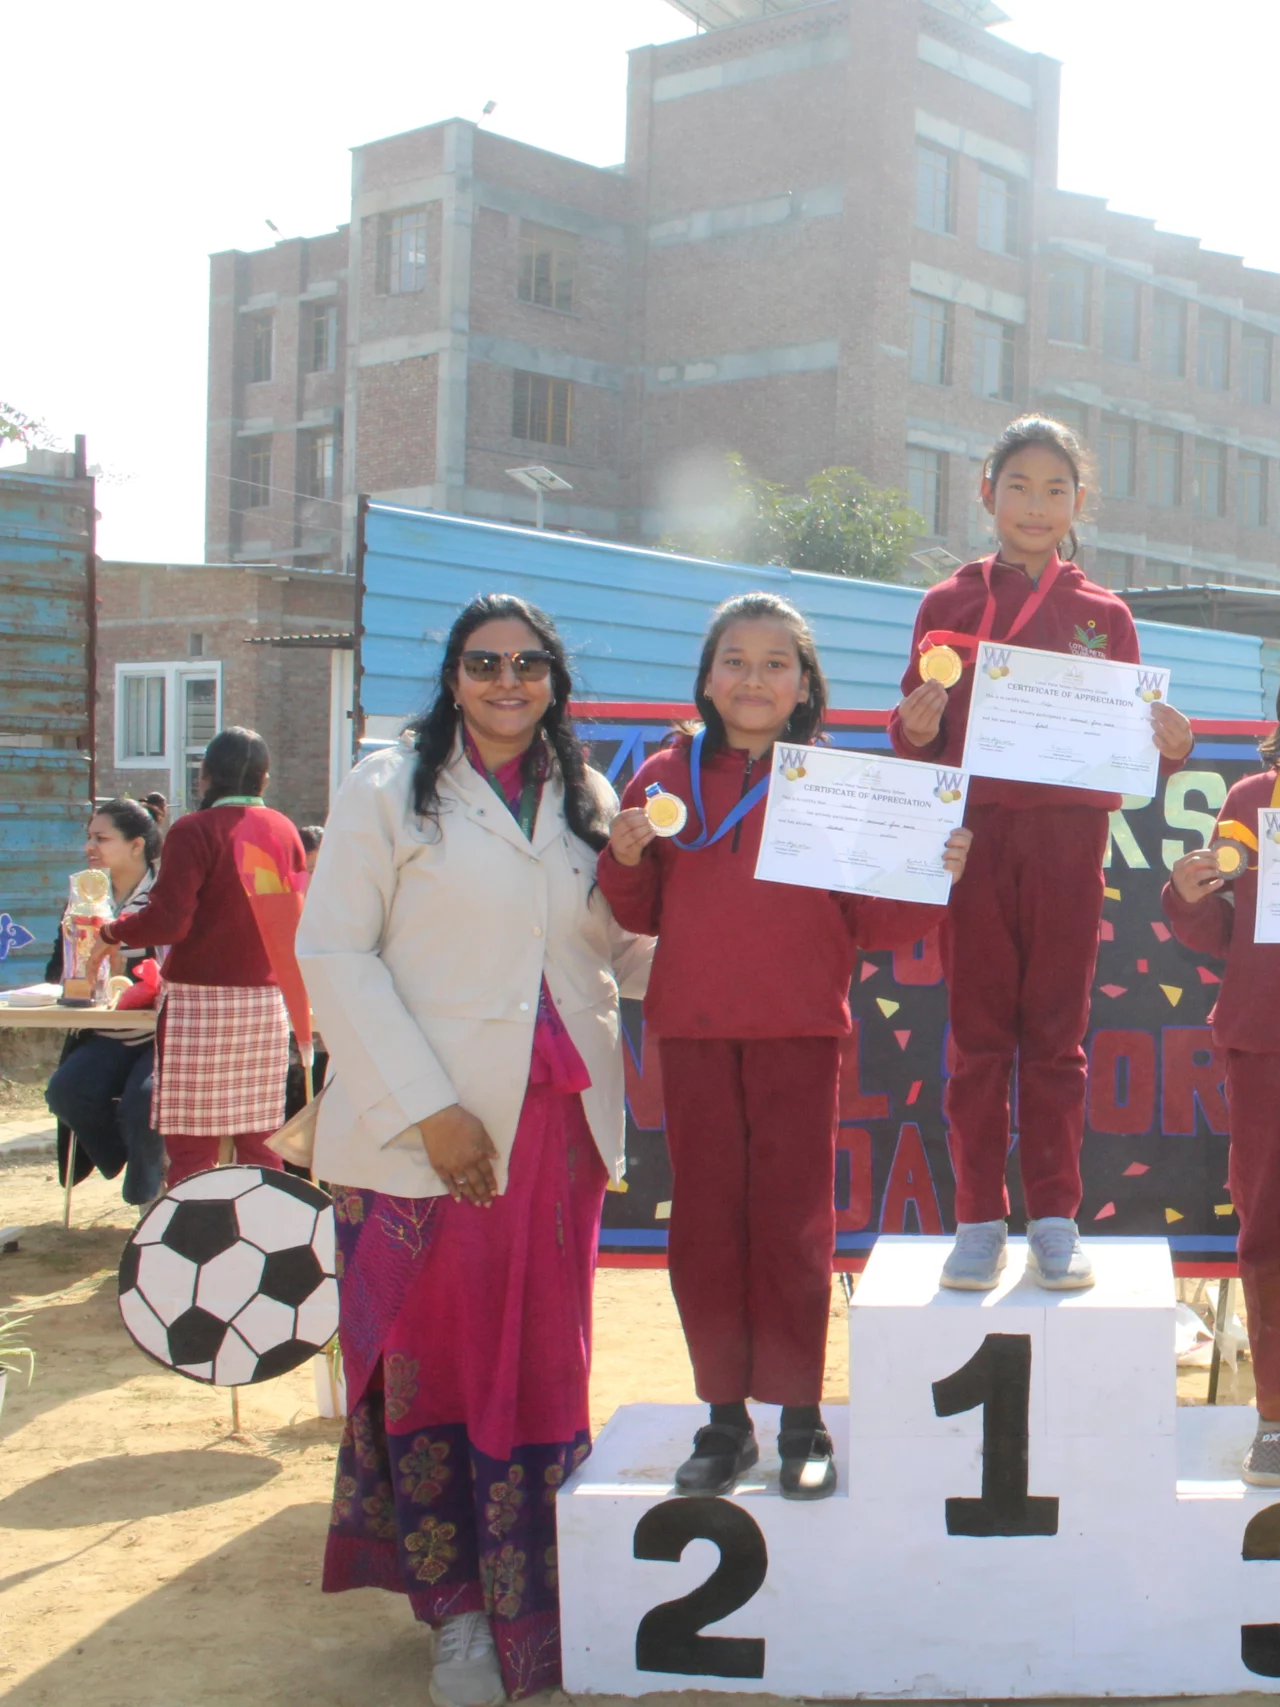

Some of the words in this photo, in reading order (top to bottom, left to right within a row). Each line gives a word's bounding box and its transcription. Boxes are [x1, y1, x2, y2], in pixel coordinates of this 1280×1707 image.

[1007, 682, 1059, 696] CERTIFICATE
[1061, 690, 1072, 698] OF
[1074, 692, 1133, 707] APPRECIATION
[803, 783, 856, 797] CERTIFICATE
[858, 791, 869, 799] OF
[871, 793, 932, 808] APPRECIATION
[932, 1332, 1059, 1537] 1
[632, 1496, 768, 1678] 2
